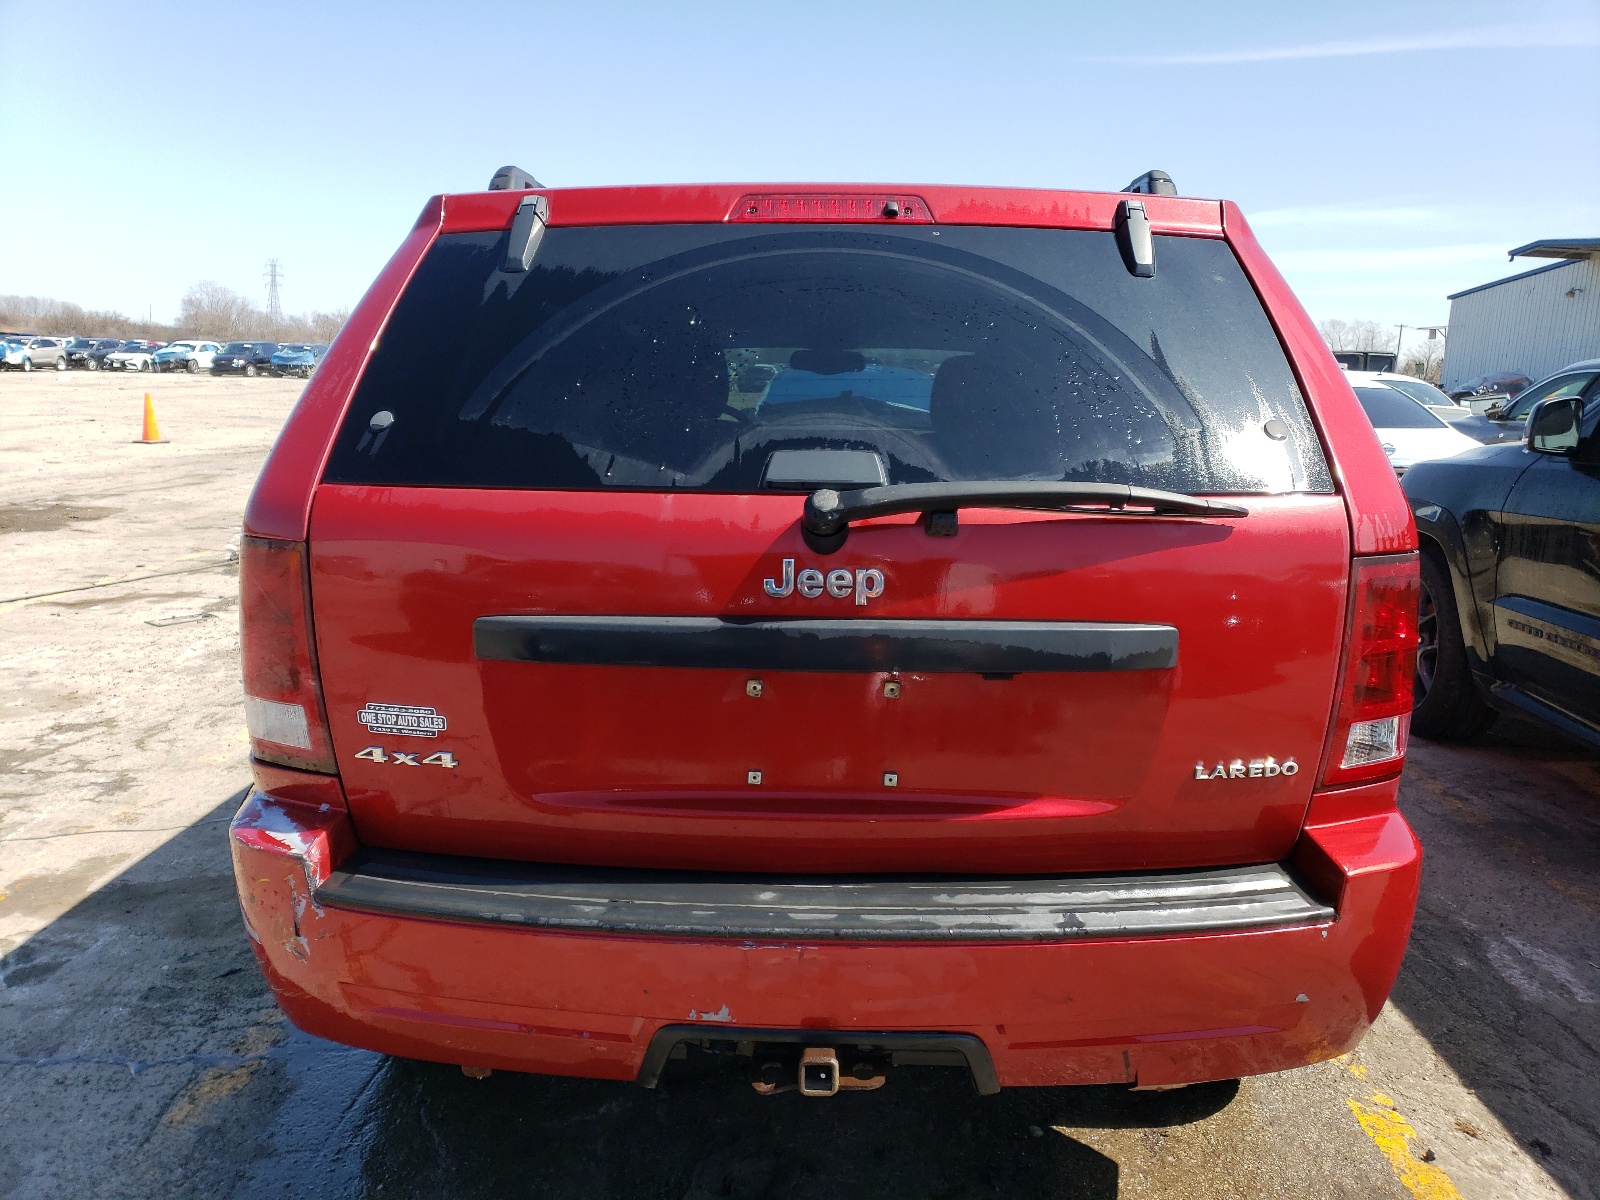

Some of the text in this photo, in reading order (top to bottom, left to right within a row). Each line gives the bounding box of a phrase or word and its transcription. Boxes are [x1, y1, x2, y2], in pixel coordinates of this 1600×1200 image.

[763, 558, 885, 606] Jeep
[361, 712, 444, 729] ONE STOP AUTO SALES
[354, 745, 459, 769] 4x4
[1194, 758, 1299, 780] LAREDO
